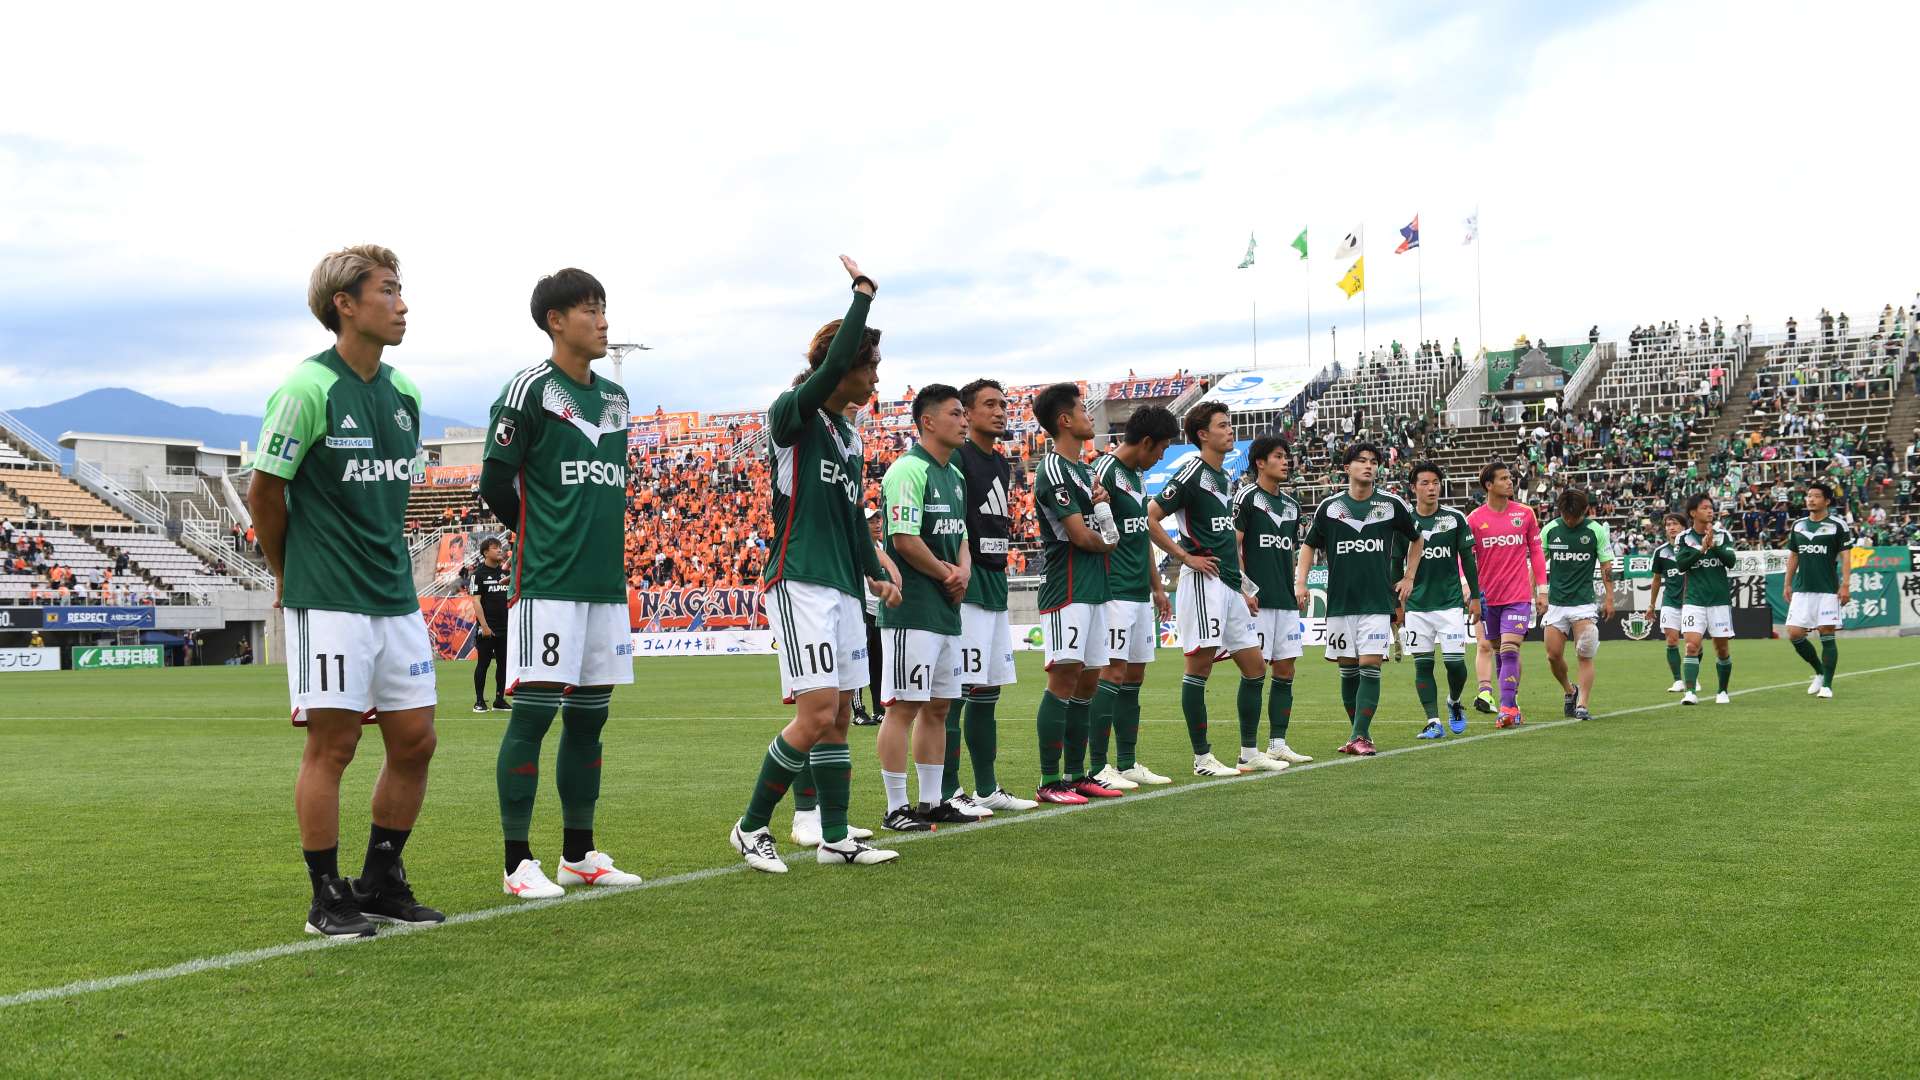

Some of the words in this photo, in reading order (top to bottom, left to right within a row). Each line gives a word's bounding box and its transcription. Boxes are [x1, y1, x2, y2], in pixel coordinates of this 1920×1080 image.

[1114, 379, 1188, 400] 大野佑哉
[560, 460, 626, 489] EPSON
[892, 505, 920, 523] SBC
[1336, 539, 1384, 555] EPSON
[1482, 534, 1524, 549] EPSON
[67, 612, 108, 623] RESPECT
[1210, 618, 1221, 638] 3
[643, 637, 703, 650] ゴムノイナキ
[1068, 626, 1079, 650] 2
[1109, 628, 1127, 650] 15
[1328, 632, 1347, 650] 46
[99, 648, 159, 666] 長野日報
[542, 632, 560, 667] 8
[804, 641, 835, 674] 10
[960, 648, 982, 673] 13
[316, 653, 345, 693] 11
[909, 664, 931, 691] 41
